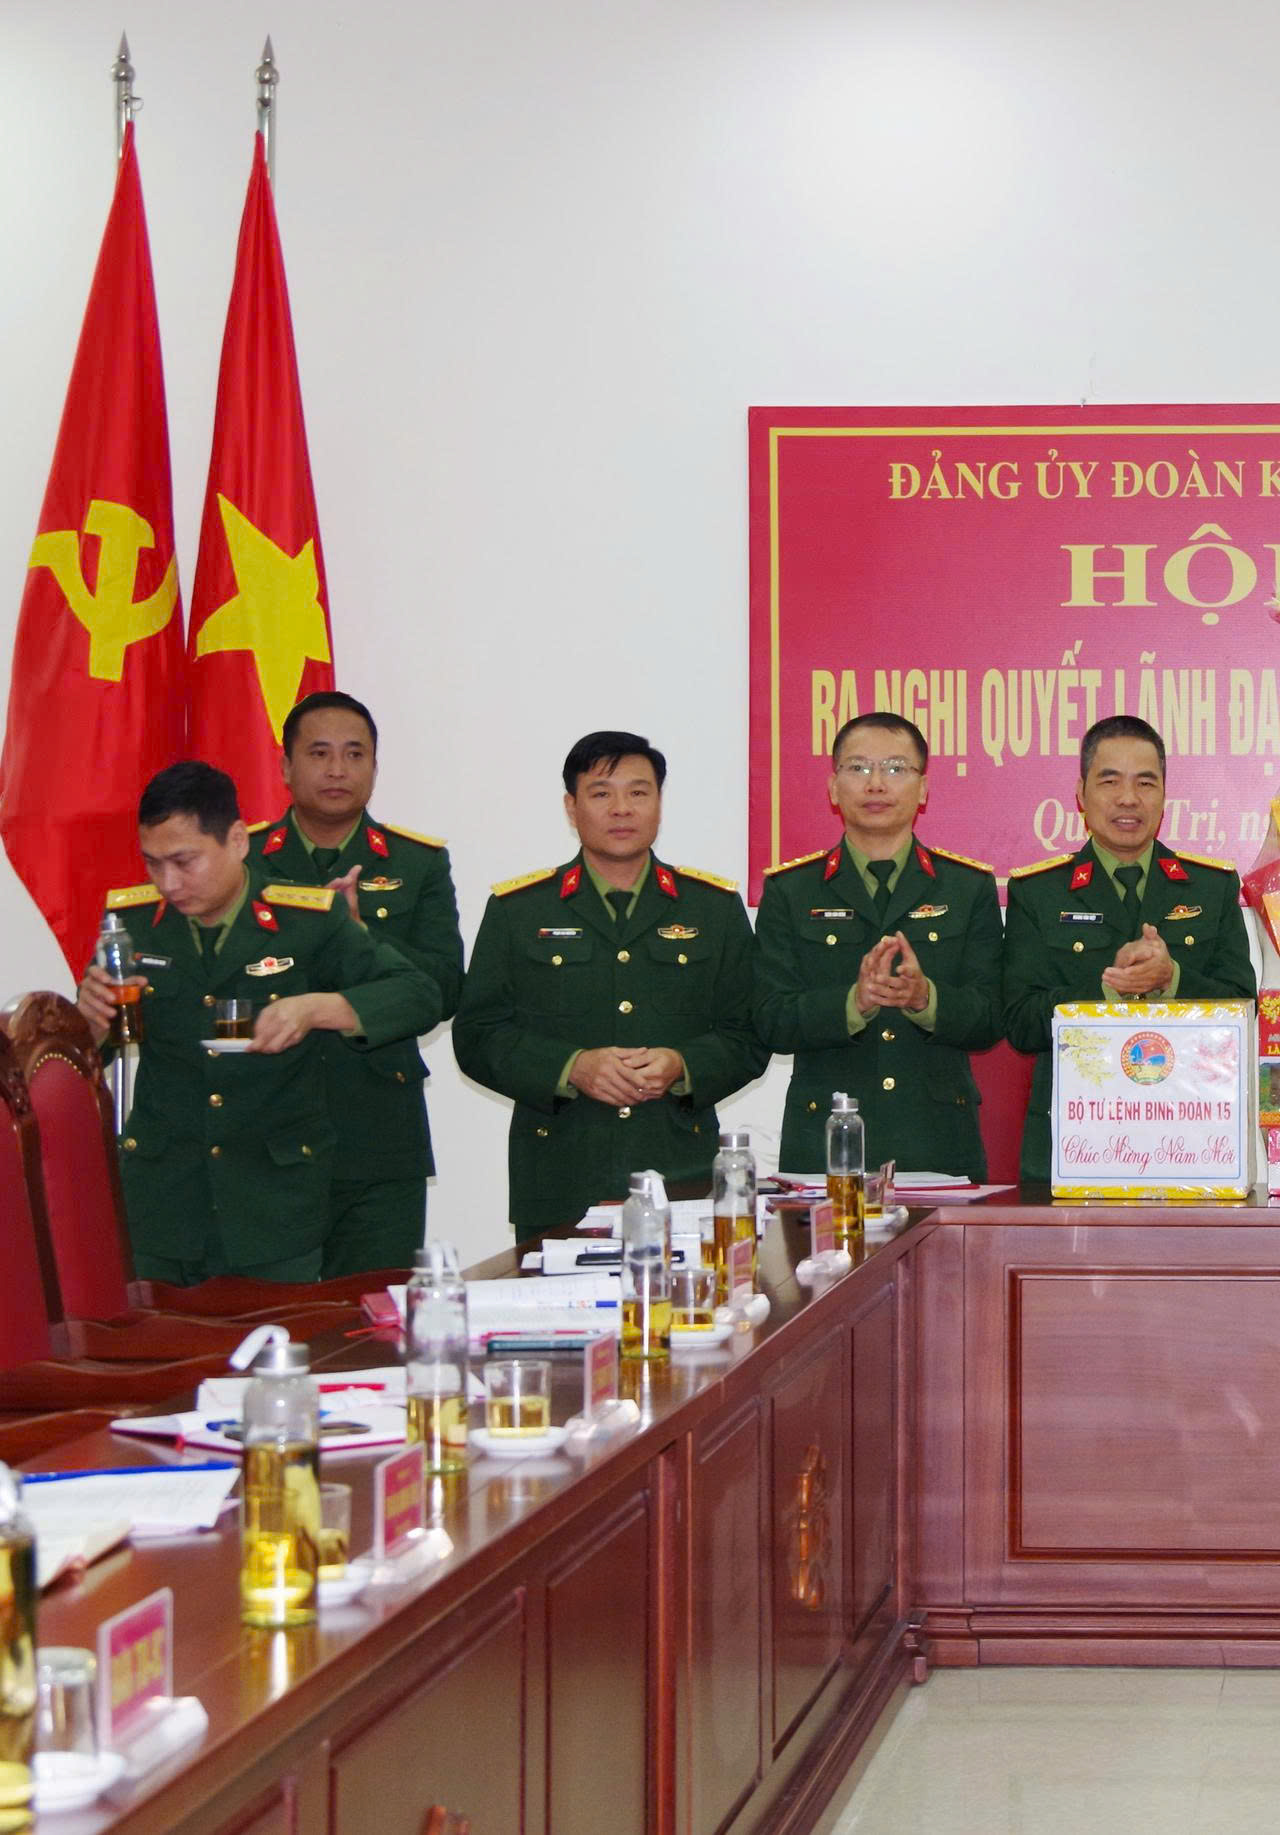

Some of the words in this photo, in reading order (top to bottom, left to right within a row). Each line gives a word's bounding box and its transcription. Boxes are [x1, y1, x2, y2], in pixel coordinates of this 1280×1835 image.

[888, 449, 1022, 499] ĐẢNG
[1035, 449, 1099, 499] ỦY
[1111, 449, 1245, 499] ĐOÀN
[981, 639, 1103, 767] QUYẾT
[1068, 1096, 1084, 1124] BỘ
[1108, 1096, 1141, 1124] LỆNH
[1145, 1101, 1174, 1121] BINH
[1178, 1097, 1212, 1121] ĐOÀN
[1217, 1101, 1231, 1121] 15
[1061, 1135, 1099, 1165] Chúc
[1103, 1135, 1151, 1175] Mừng
[1154, 1135, 1198, 1165] Năm
